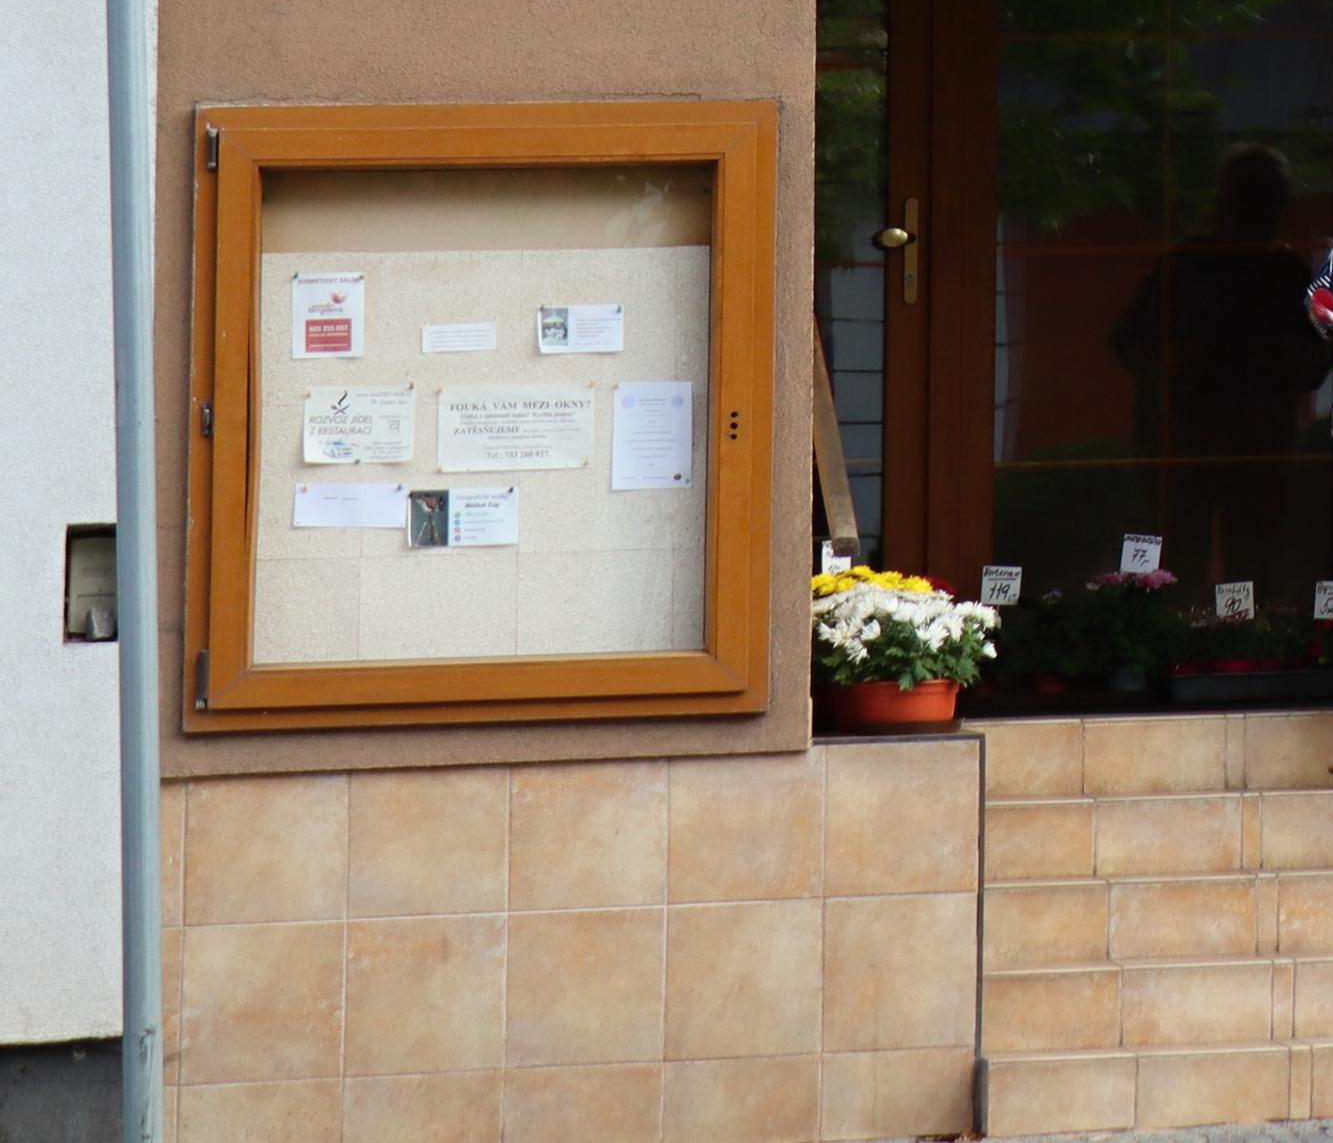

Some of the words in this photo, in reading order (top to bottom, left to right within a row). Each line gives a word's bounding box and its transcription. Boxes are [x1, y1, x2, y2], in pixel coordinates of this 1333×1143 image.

[450, 400, 488, 412] FOUKÁ
[493, 399, 517, 411] VÁM
[523, 400, 550, 410] MEZI
[555, 399, 591, 409] OKNY?
[309, 415, 349, 424] ROZVOZ
[309, 426, 317, 435] Z
